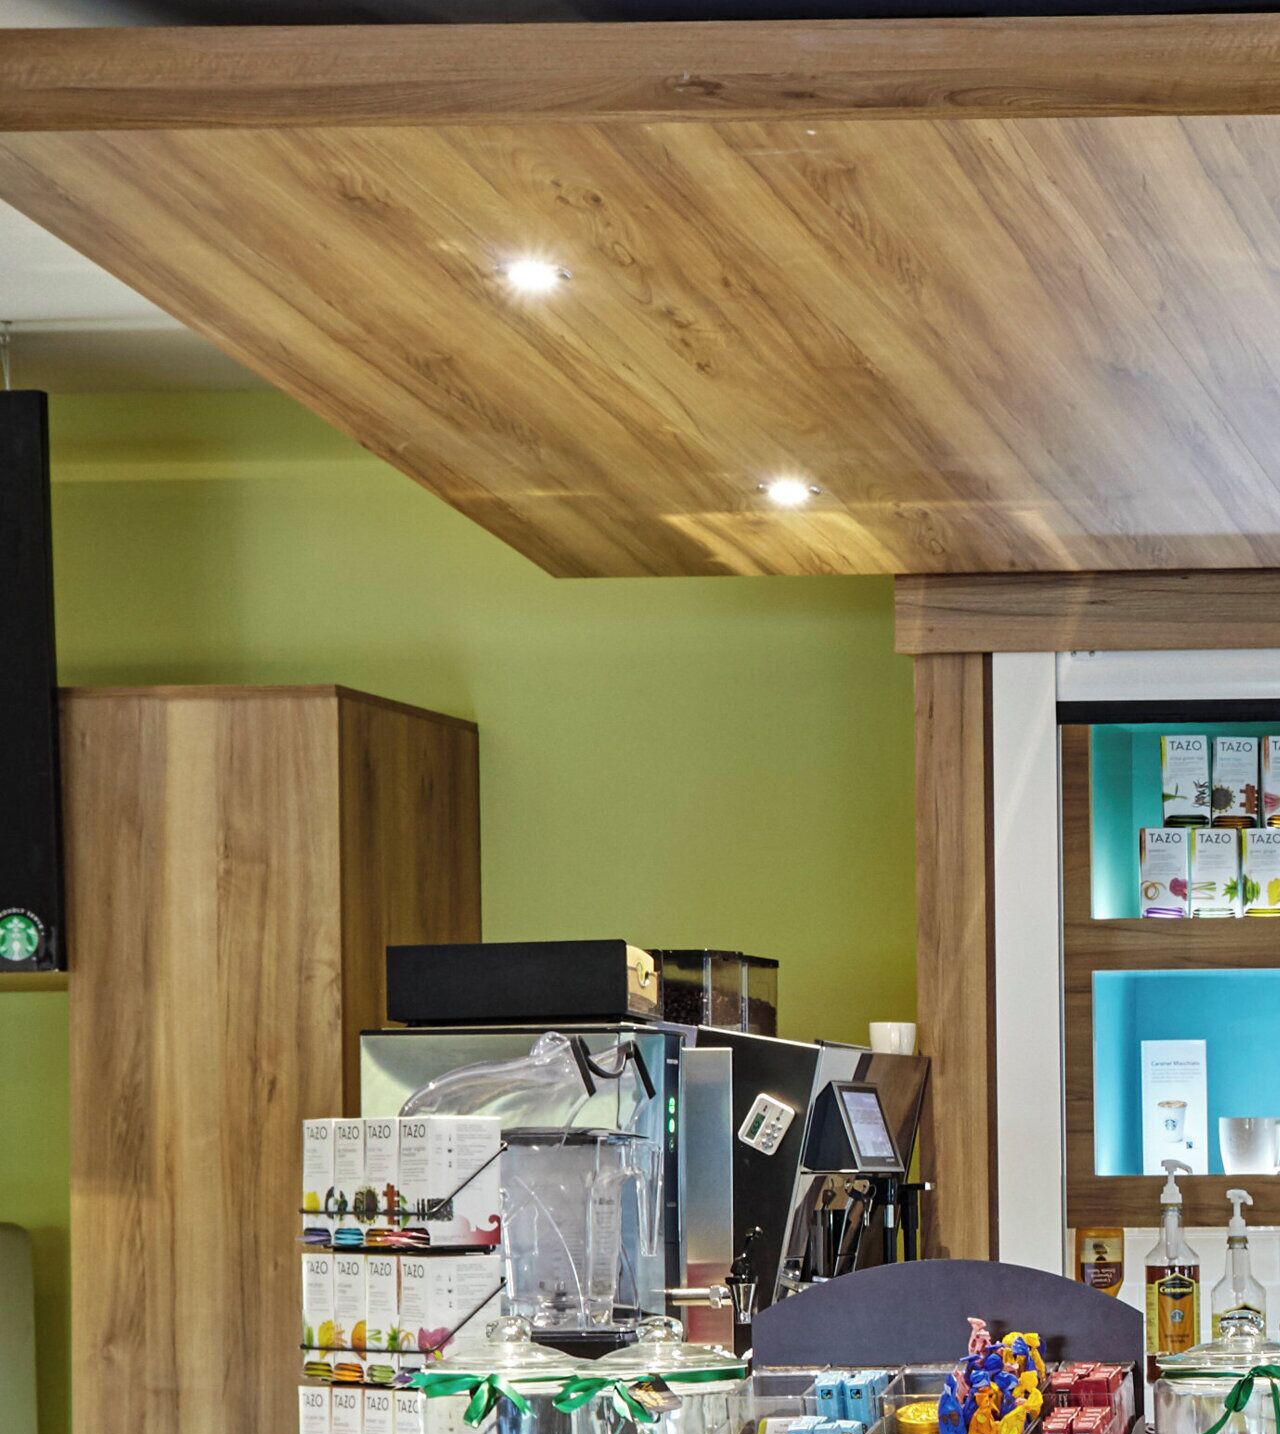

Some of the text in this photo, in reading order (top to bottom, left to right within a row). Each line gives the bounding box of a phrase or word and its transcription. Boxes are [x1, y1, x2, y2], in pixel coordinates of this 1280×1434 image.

[1169, 740, 1202, 751] TAZO
[1219, 741, 1253, 752] TAZO
[1149, 833, 1182, 844] TAZO
[1199, 833, 1232, 844] TAZO
[306, 1126, 327, 1140] TAZO
[337, 1126, 359, 1140] TAZO
[368, 1125, 391, 1139] TAZO
[402, 1124, 426, 1138] TAZO
[306, 1261, 328, 1275] TAZO
[337, 1261, 359, 1275] TAZO
[369, 1262, 392, 1276] TAZO
[402, 1264, 425, 1279] TAZO
[302, 1394, 323, 1408] TAZO
[334, 1395, 356, 1409] TAZO
[366, 1396, 389, 1411] TAZO
